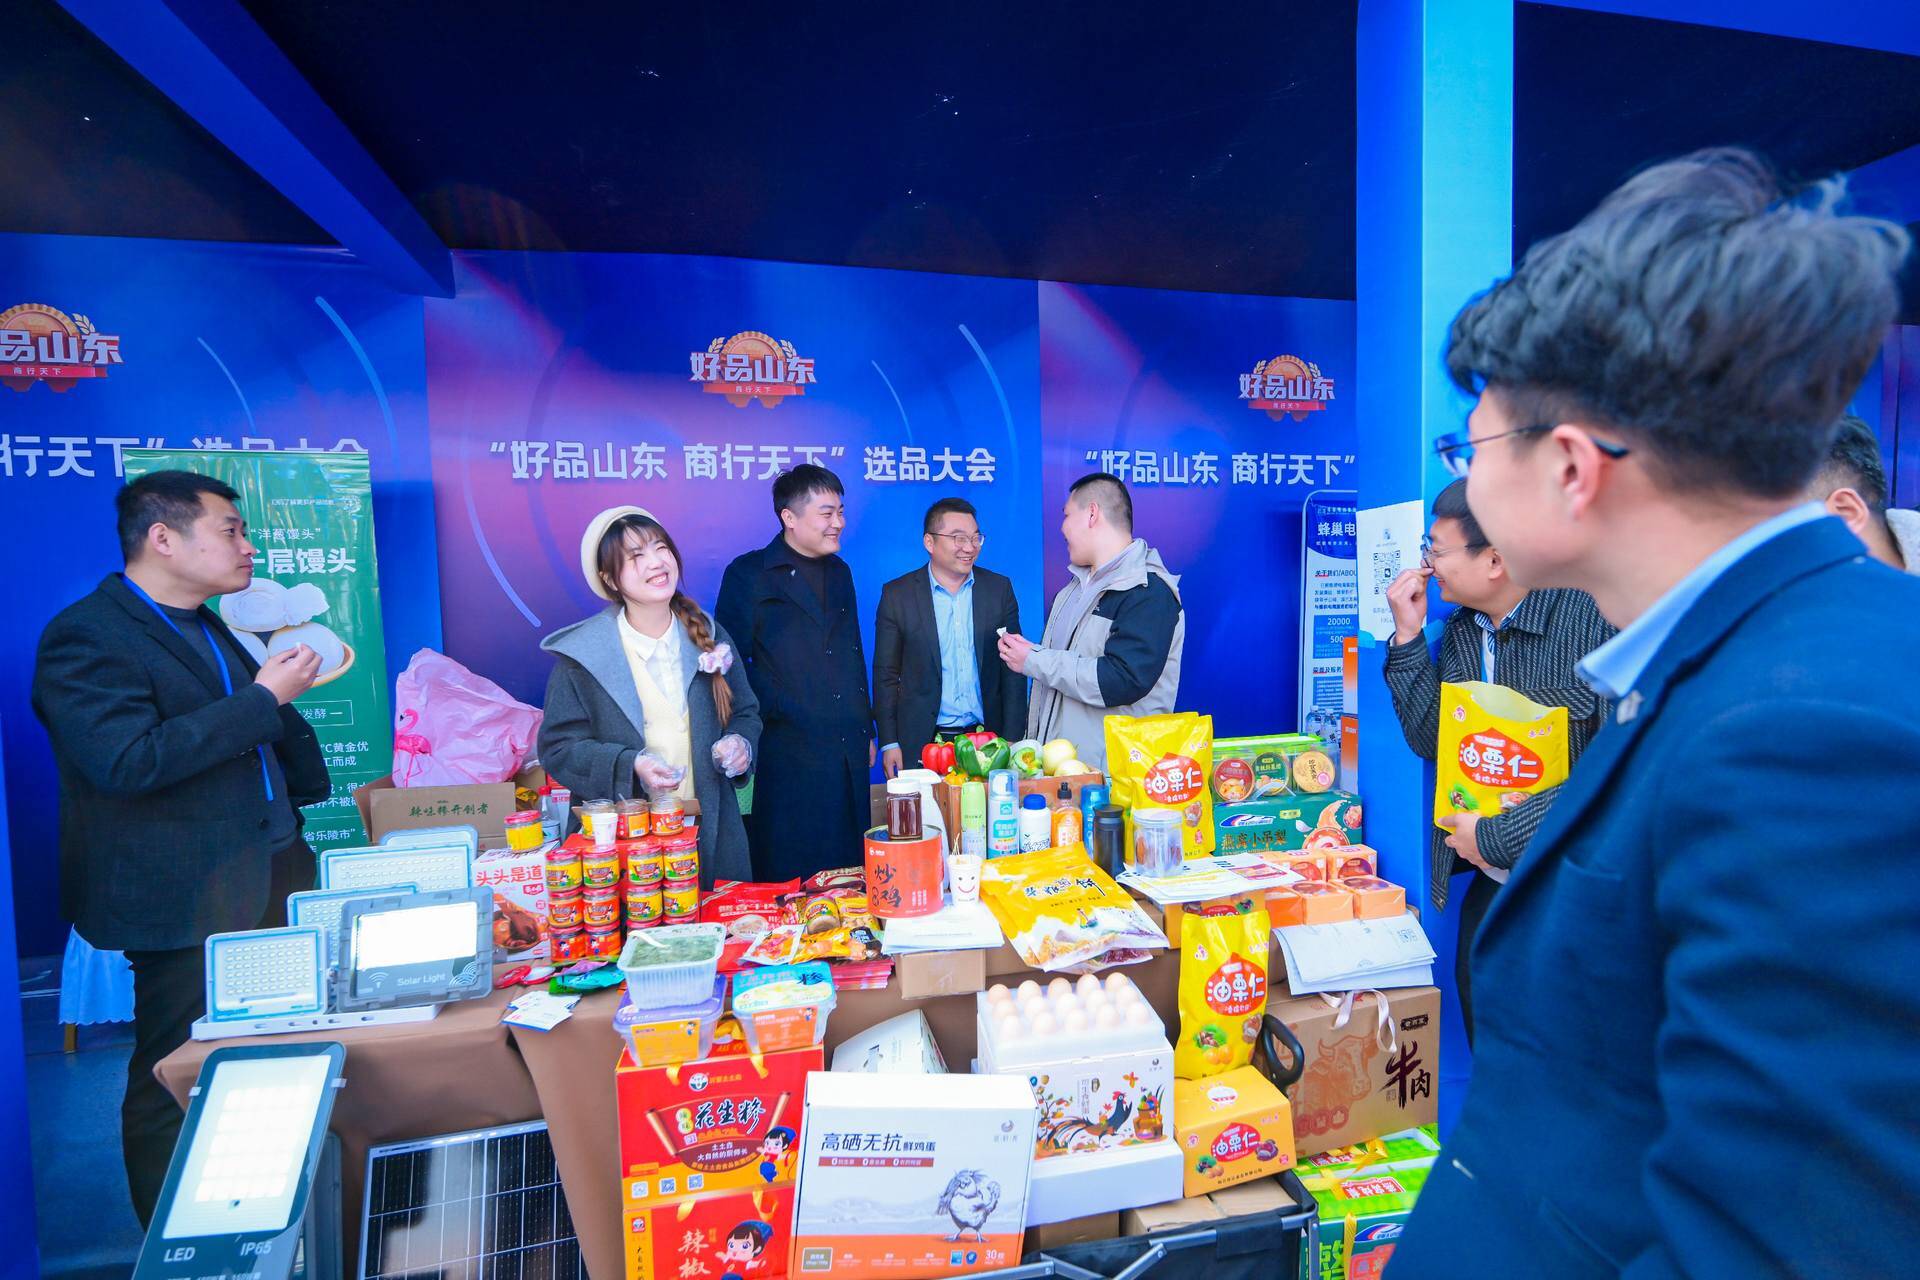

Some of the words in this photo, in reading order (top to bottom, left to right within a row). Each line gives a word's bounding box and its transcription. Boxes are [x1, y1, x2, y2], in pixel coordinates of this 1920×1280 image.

[0, 330, 123, 364] 品山东
[690, 353, 817, 384] 好品山东
[1239, 373, 1335, 400] 好品山东
[490, 440, 668, 480] “好品山东
[864, 446, 996, 482] 选品大会
[1086, 450, 1220, 485] “好品山东
[1231, 451, 1356, 486] 商行天下”
[1327, 617, 1351, 626] 20000
[1459, 742, 1539, 779] 油栗仁
[1145, 766, 1202, 797] 油栗仁
[476, 864, 544, 887] 头头是道
[397, 975, 421, 987] Solar
[423, 972, 447, 985] Light
[1207, 972, 1266, 1004] 油栗仁
[1379, 1039, 1431, 1111] 牛肉
[821, 1132, 903, 1152] 高硒无抗
[902, 1141, 936, 1152] 鲜鸡蛋
[163, 1246, 196, 1263] LED
[240, 1240, 273, 1257] IP65
[677, 1228, 713, 1280] 辣椒
